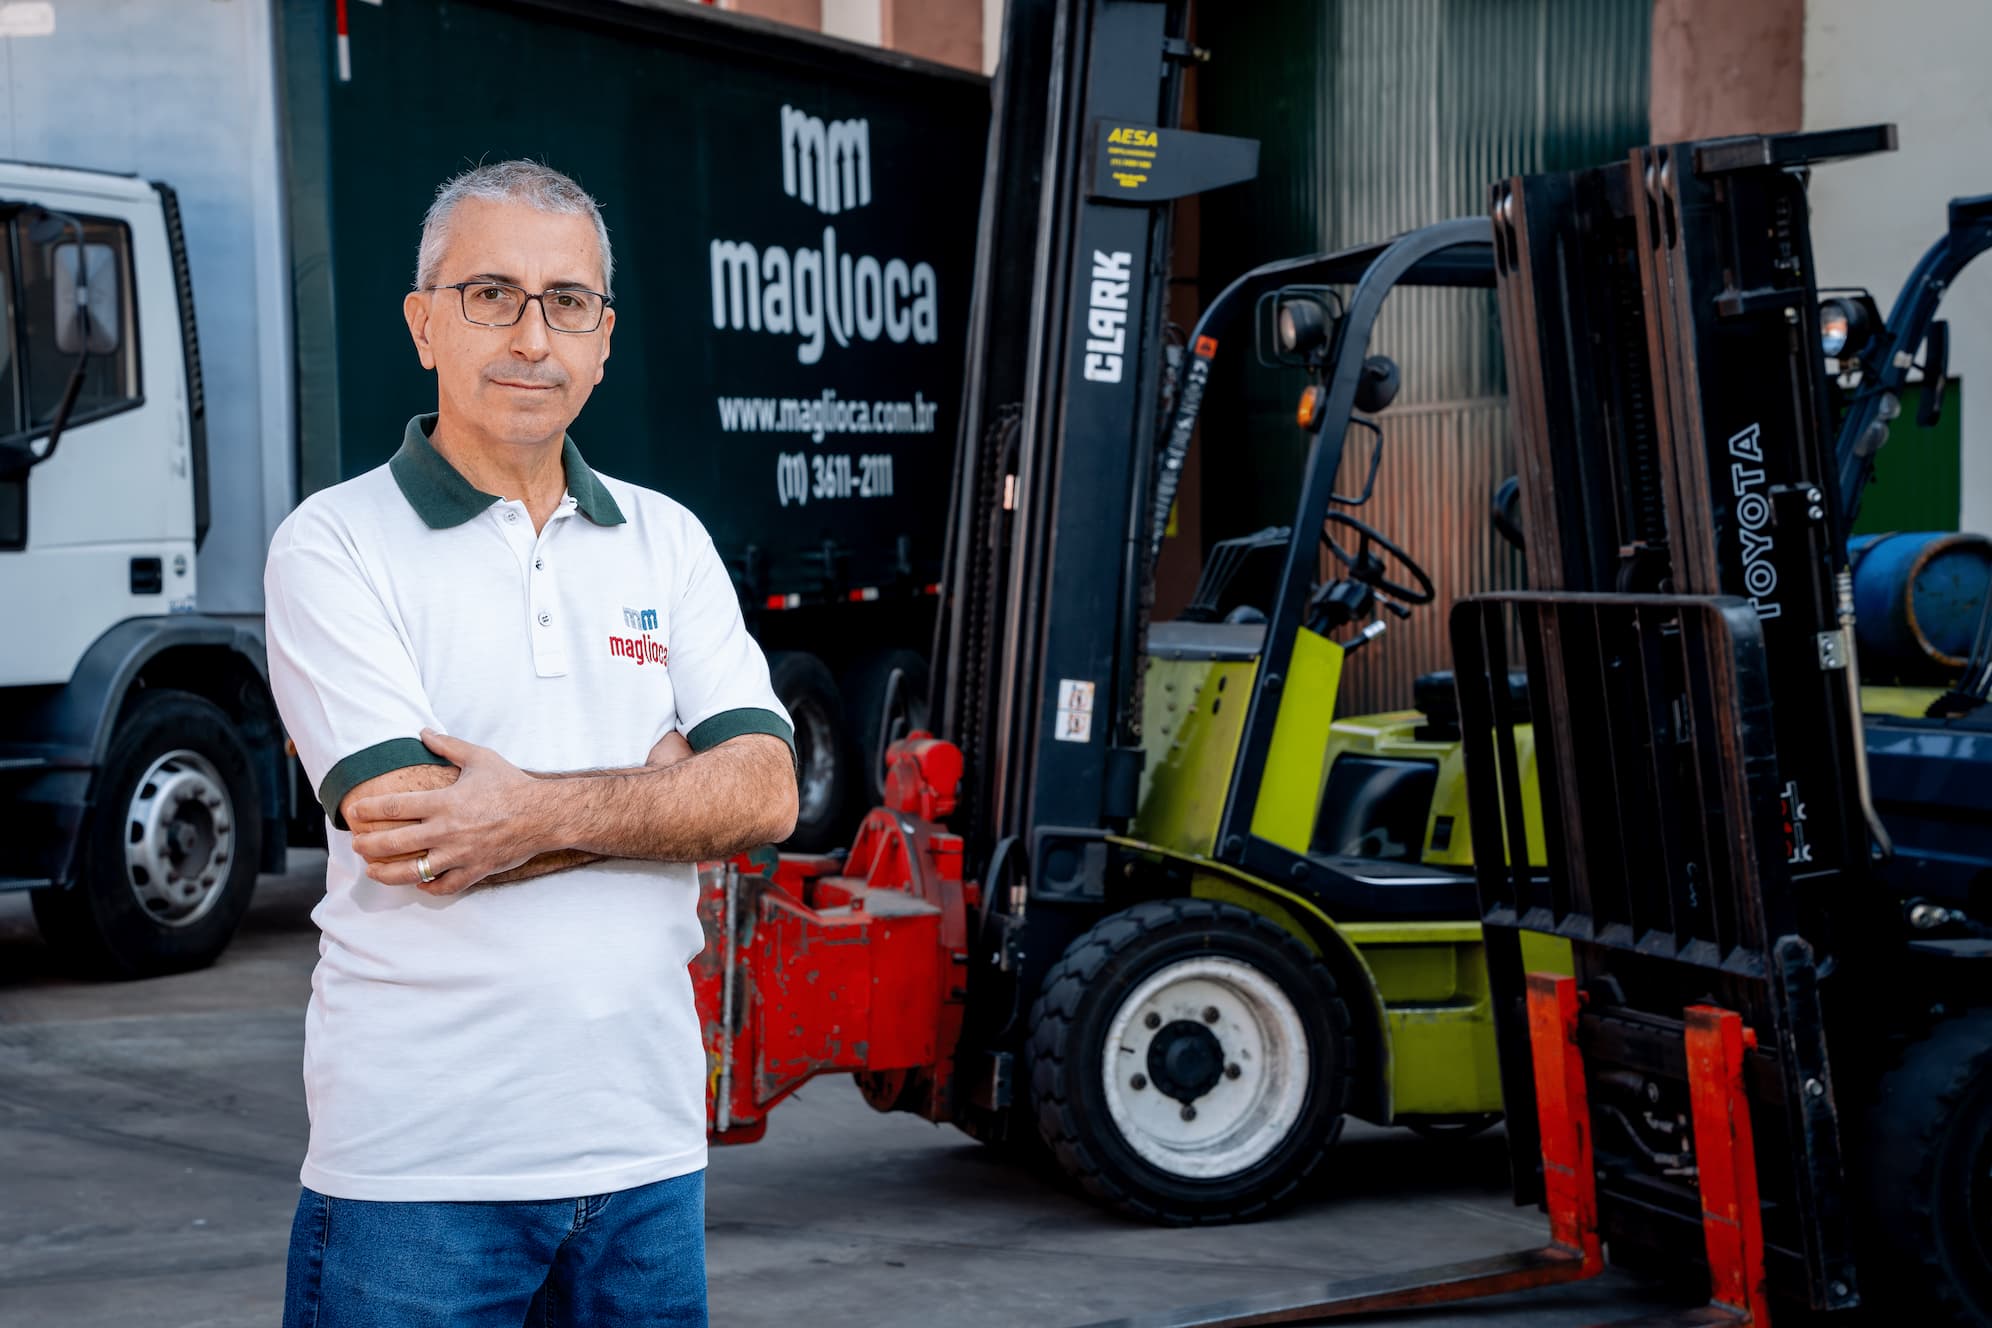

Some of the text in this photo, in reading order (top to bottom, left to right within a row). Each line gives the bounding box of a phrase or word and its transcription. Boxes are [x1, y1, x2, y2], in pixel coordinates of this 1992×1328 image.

[1107, 127, 1158, 148] AESA
[710, 226, 938, 364] maglioca
[1084, 249, 1132, 384] CLARK
[717, 388, 938, 443] www.maglioca.com.br
[777, 451, 894, 507] (11) 3611-2111
[1728, 422, 1782, 620] TOYOTA
[622, 606, 658, 631] mm
[609, 633, 668, 668] maglioca
